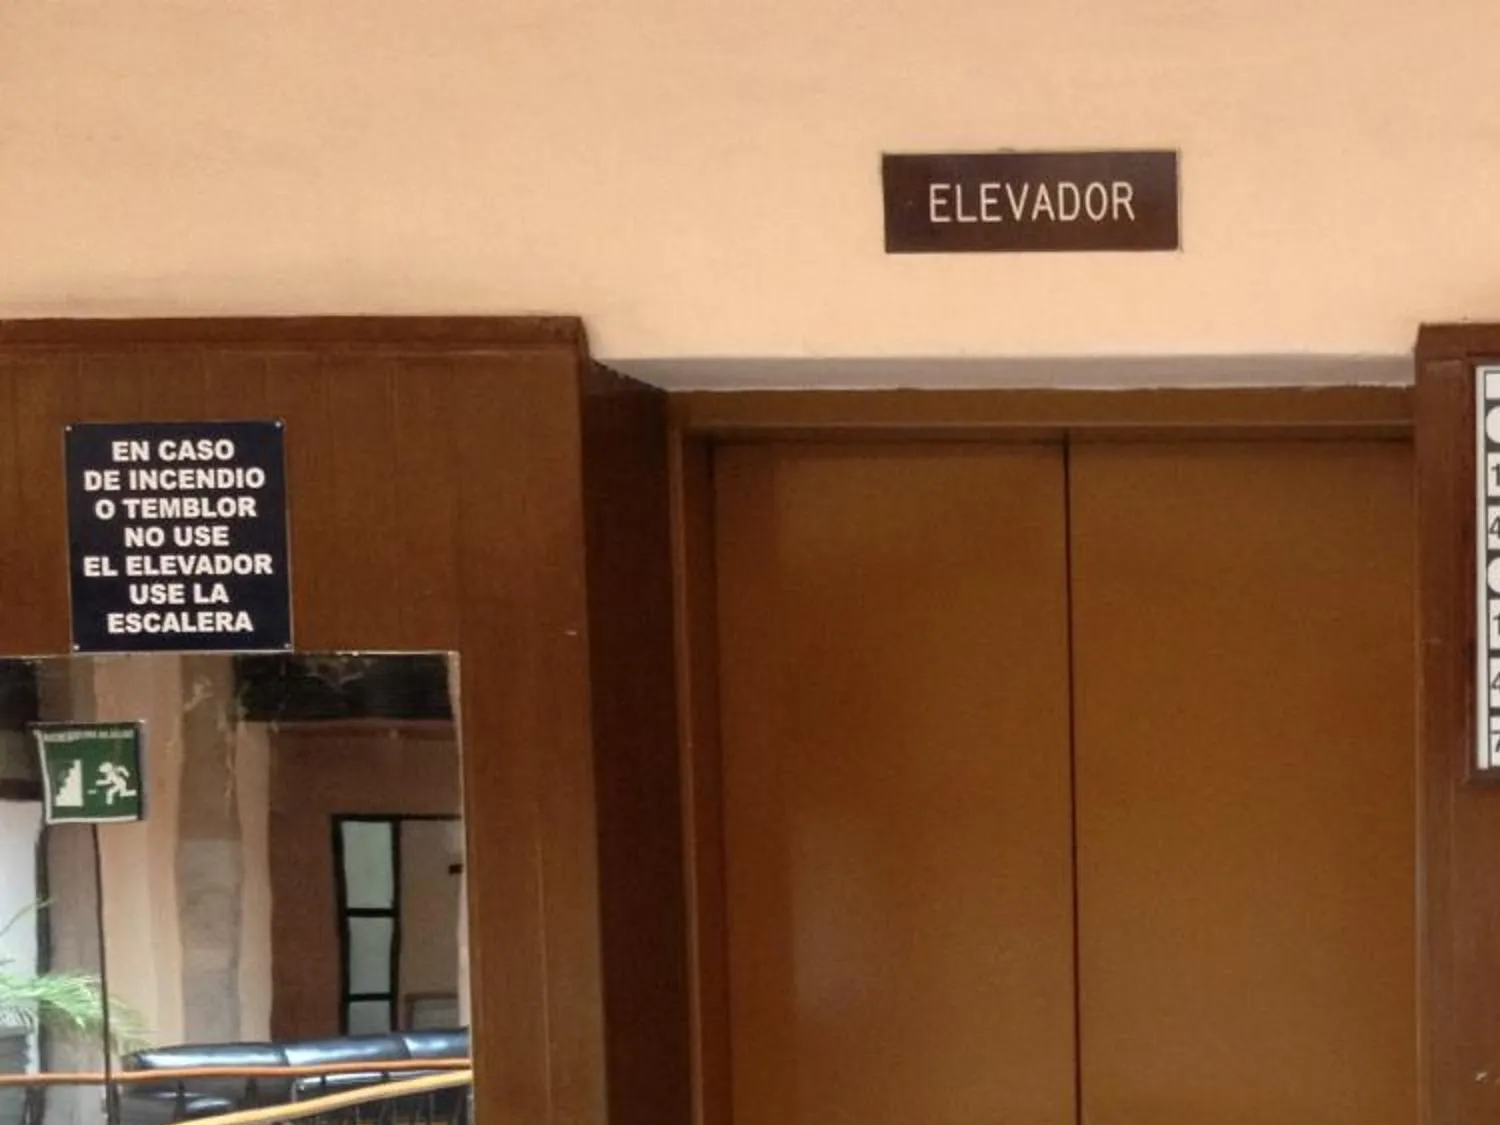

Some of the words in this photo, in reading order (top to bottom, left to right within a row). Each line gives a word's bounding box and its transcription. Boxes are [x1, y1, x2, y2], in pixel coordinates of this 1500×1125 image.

[929, 181, 1135, 223] ELEVADOR
[112, 441, 150, 461] EN
[158, 439, 235, 461] CASO
[84, 470, 120, 491] DE
[129, 467, 265, 489] INCENDIO
[95, 499, 115, 520] O
[123, 496, 257, 519] TEMBLOR
[124, 527, 165, 548] NO
[173, 526, 229, 547] USE
[83, 557, 118, 577] EL
[126, 554, 273, 576] ELEVADOR
[129, 584, 185, 605] USE
[193, 584, 229, 604] LA
[107, 612, 254, 634] ESCALERA
